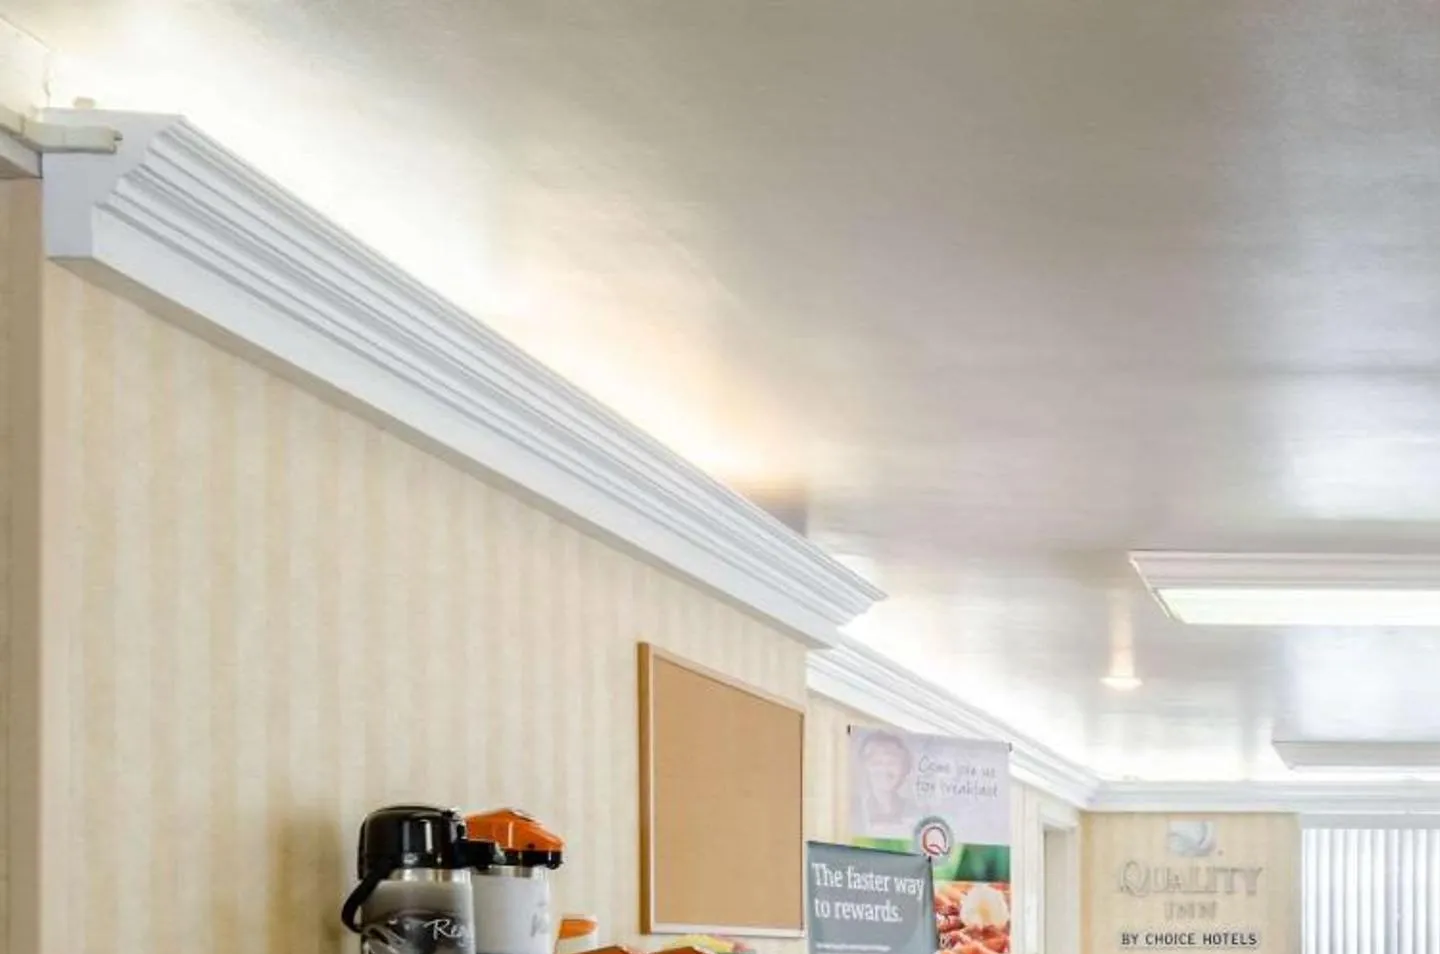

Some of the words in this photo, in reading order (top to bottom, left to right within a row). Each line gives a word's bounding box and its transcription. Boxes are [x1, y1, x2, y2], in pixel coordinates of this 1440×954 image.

[811, 862, 843, 888] The
[847, 863, 891, 891] faster
[894, 876, 925, 901] way
[1120, 859, 1263, 898] QUALITY
[814, 898, 831, 917] to
[834, 899, 903, 922] rewards.
[1164, 901, 1218, 920] INN
[1121, 932, 1139, 946] BY
[1145, 932, 1196, 946] CHOICE
[1202, 932, 1258, 946] HOTELS
